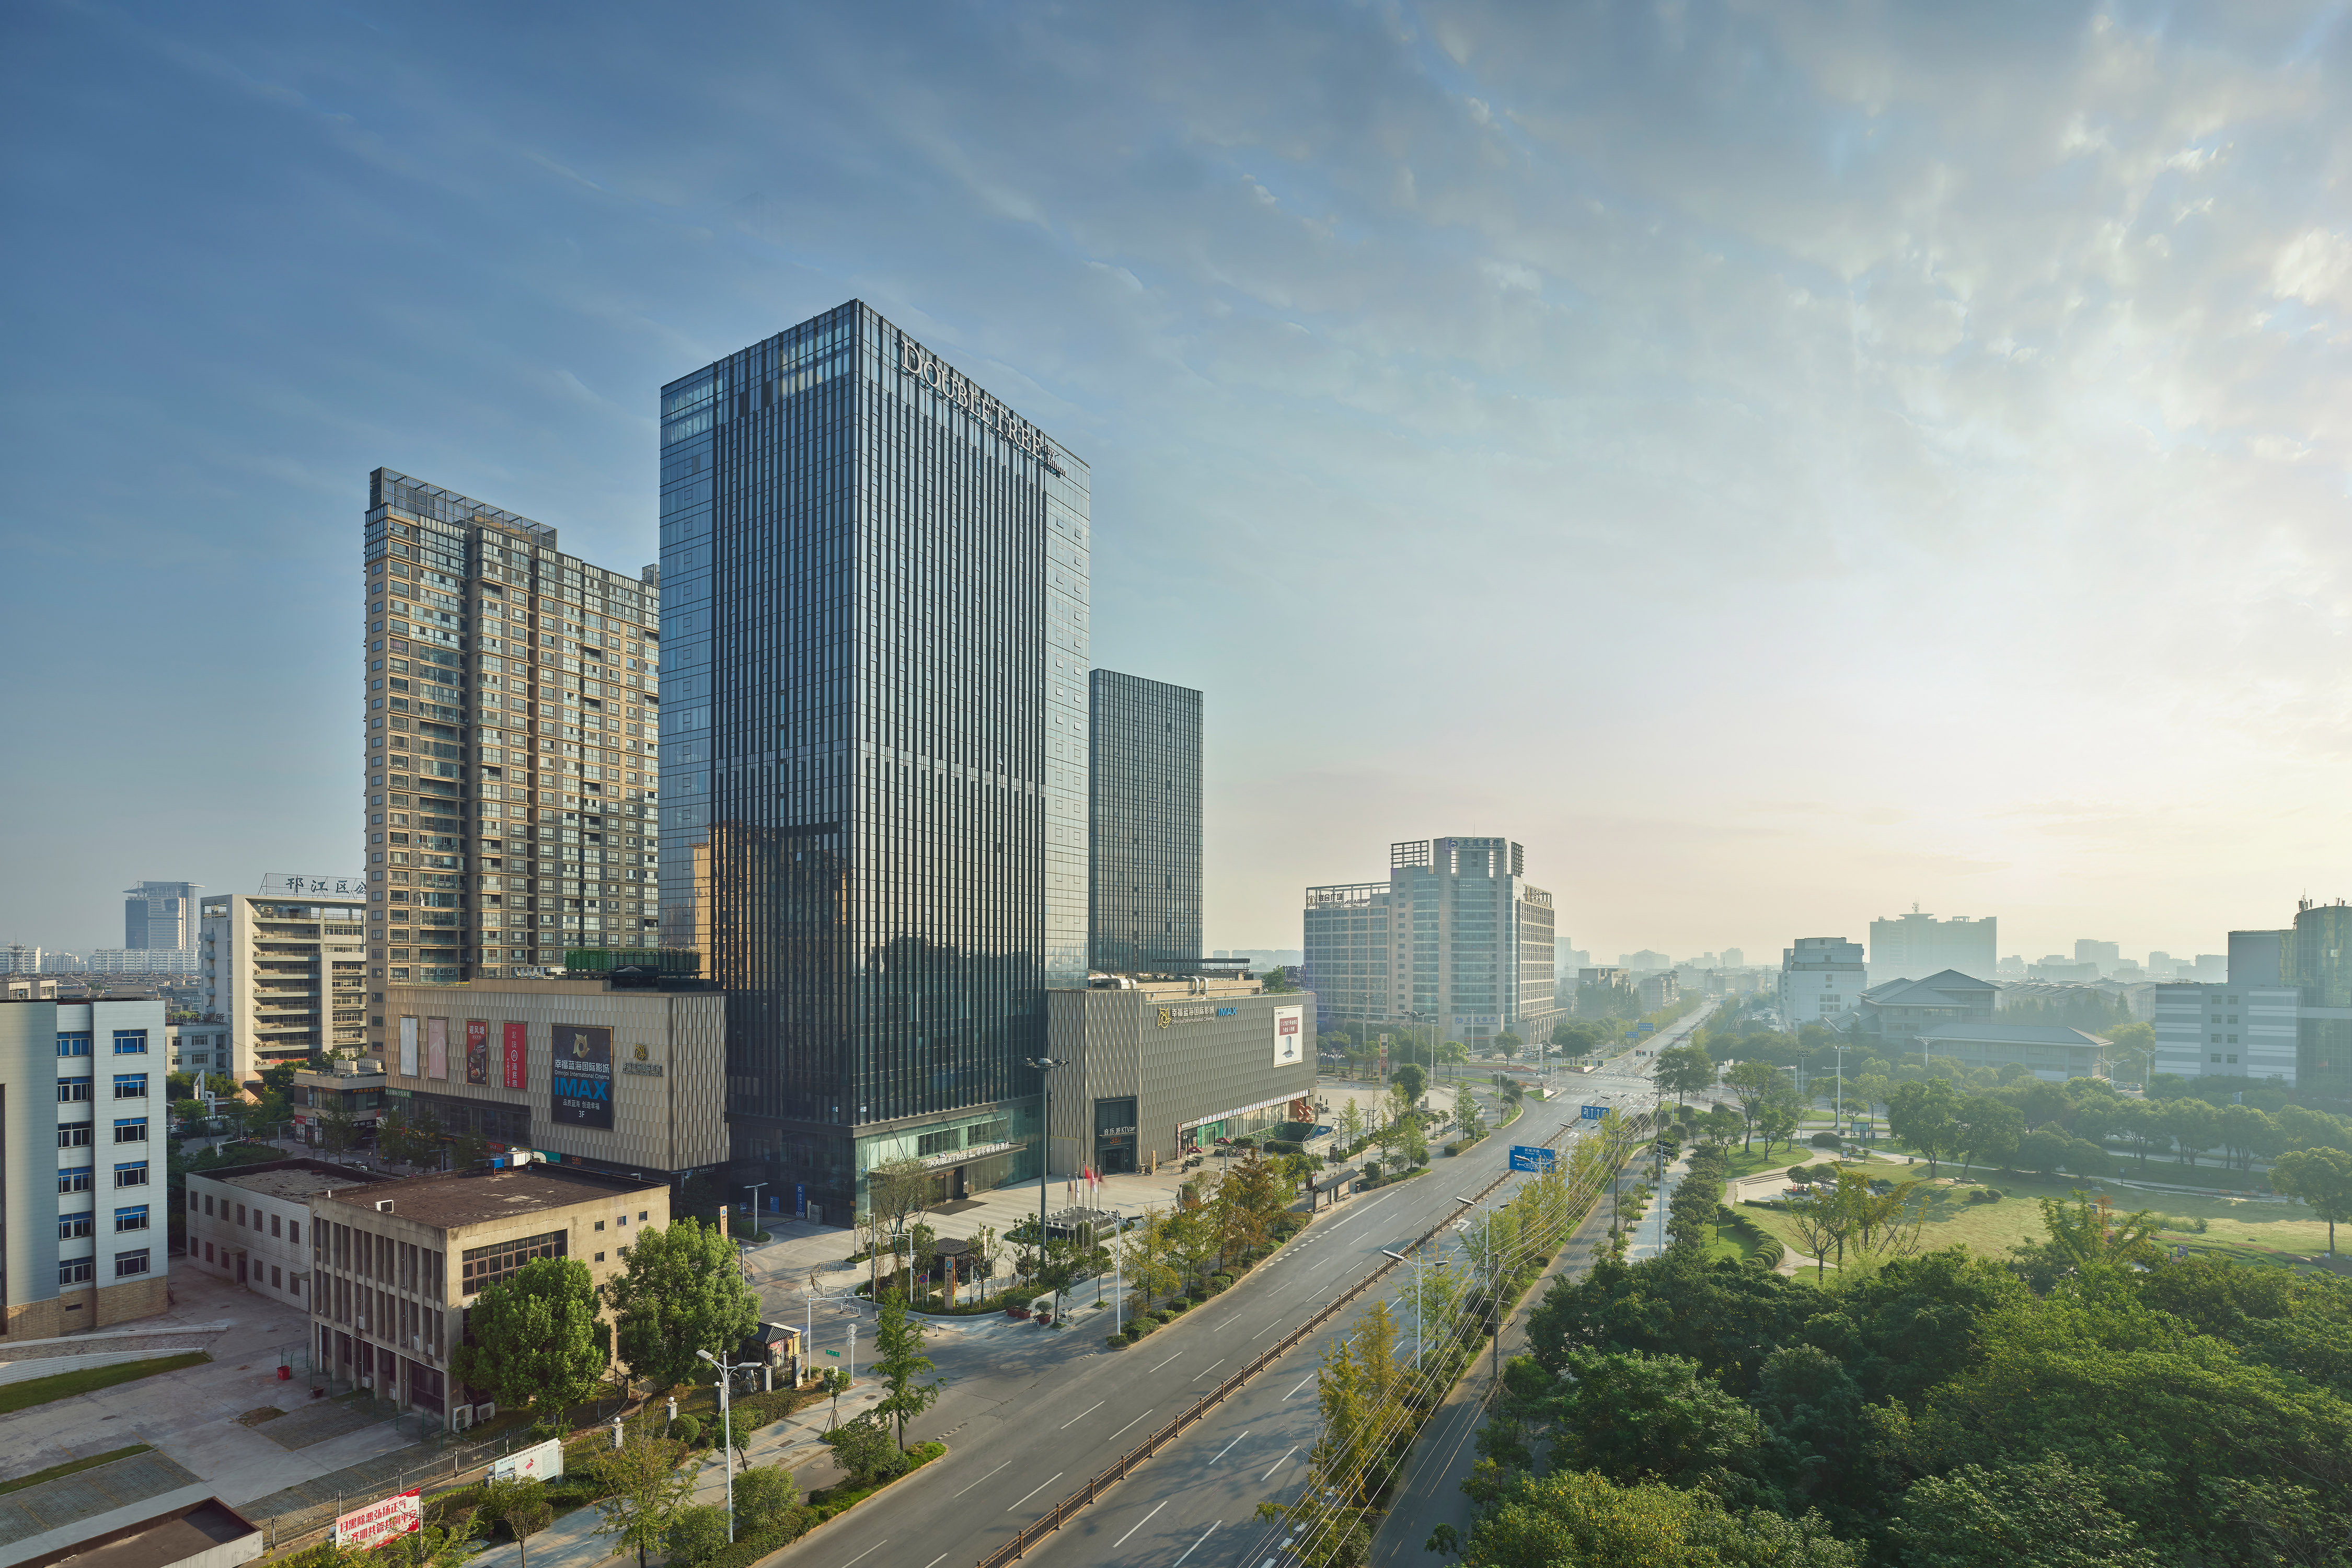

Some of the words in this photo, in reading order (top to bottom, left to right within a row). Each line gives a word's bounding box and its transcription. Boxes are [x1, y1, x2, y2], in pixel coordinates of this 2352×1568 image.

[902, 339, 1042, 458] DOUBLETREE
[1047, 445, 1055, 458] by
[1047, 455, 1067, 476] Hilton
[1171, 1006, 1214, 1018] 幸福蓝海国际影城
[1218, 1007, 1237, 1017] IMAX
[469, 1025, 485, 1035] 避风塘
[555, 1059, 609, 1074] 幸福蓝海国际影城
[622, 1063, 661, 1072] 幸福蓝海国际影城
[570, 1070, 594, 1079] International
[555, 1077, 608, 1101] IMAX
[563, 1099, 580, 1108] 品质蓝海
[582, 1101, 600, 1110] 创造幸福
[976, 1142, 1010, 1156] 希尔顿逸林酒店
[927, 1152, 967, 1168] DOUBLETREE
[340, 1499, 407, 1534] 扫黑除恶弘扬正气
